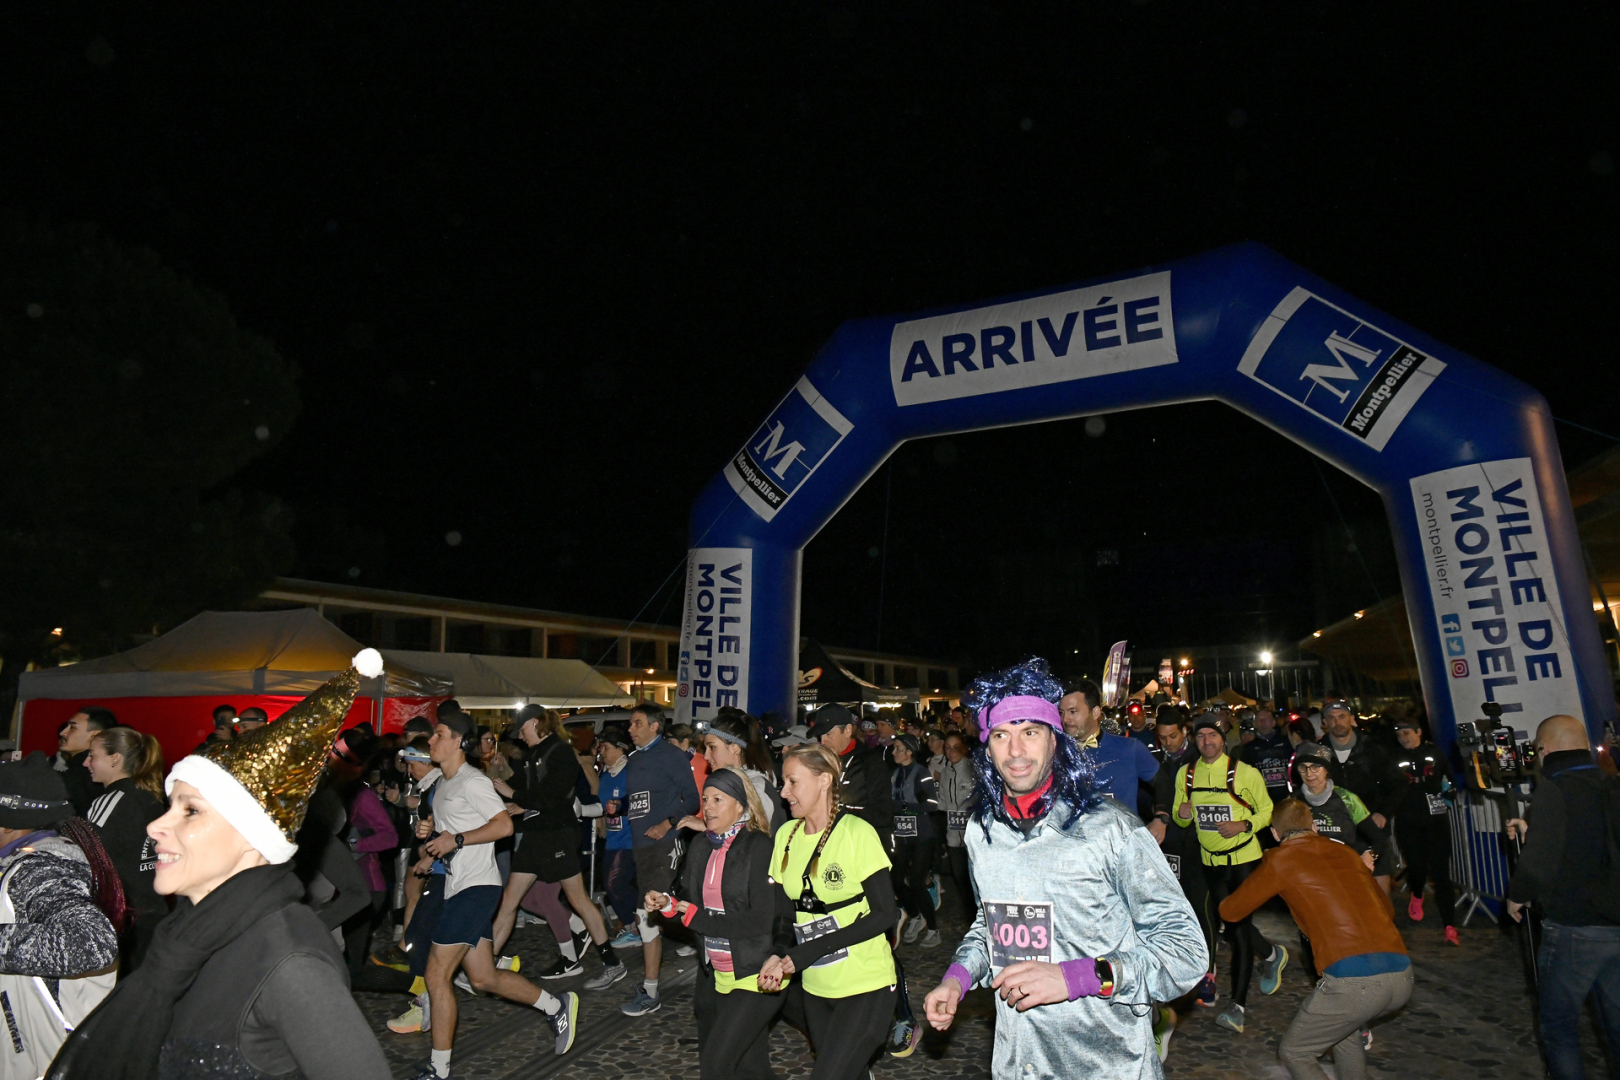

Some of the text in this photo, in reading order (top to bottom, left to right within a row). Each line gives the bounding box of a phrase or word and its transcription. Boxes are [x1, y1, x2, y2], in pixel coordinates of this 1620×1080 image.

[901, 296, 1163, 382] ARRIVÉE
[1351, 352, 1418, 431] Montpellier
[736, 453, 782, 504] Montpellier
[1423, 492, 1454, 599] montpellier.fr
[1491, 478, 1562, 682] VILLE DE
[716, 563, 743, 708] VILLE DE
[1200, 812, 1229, 823] 9106
[993, 922, 1048, 949] 4003
